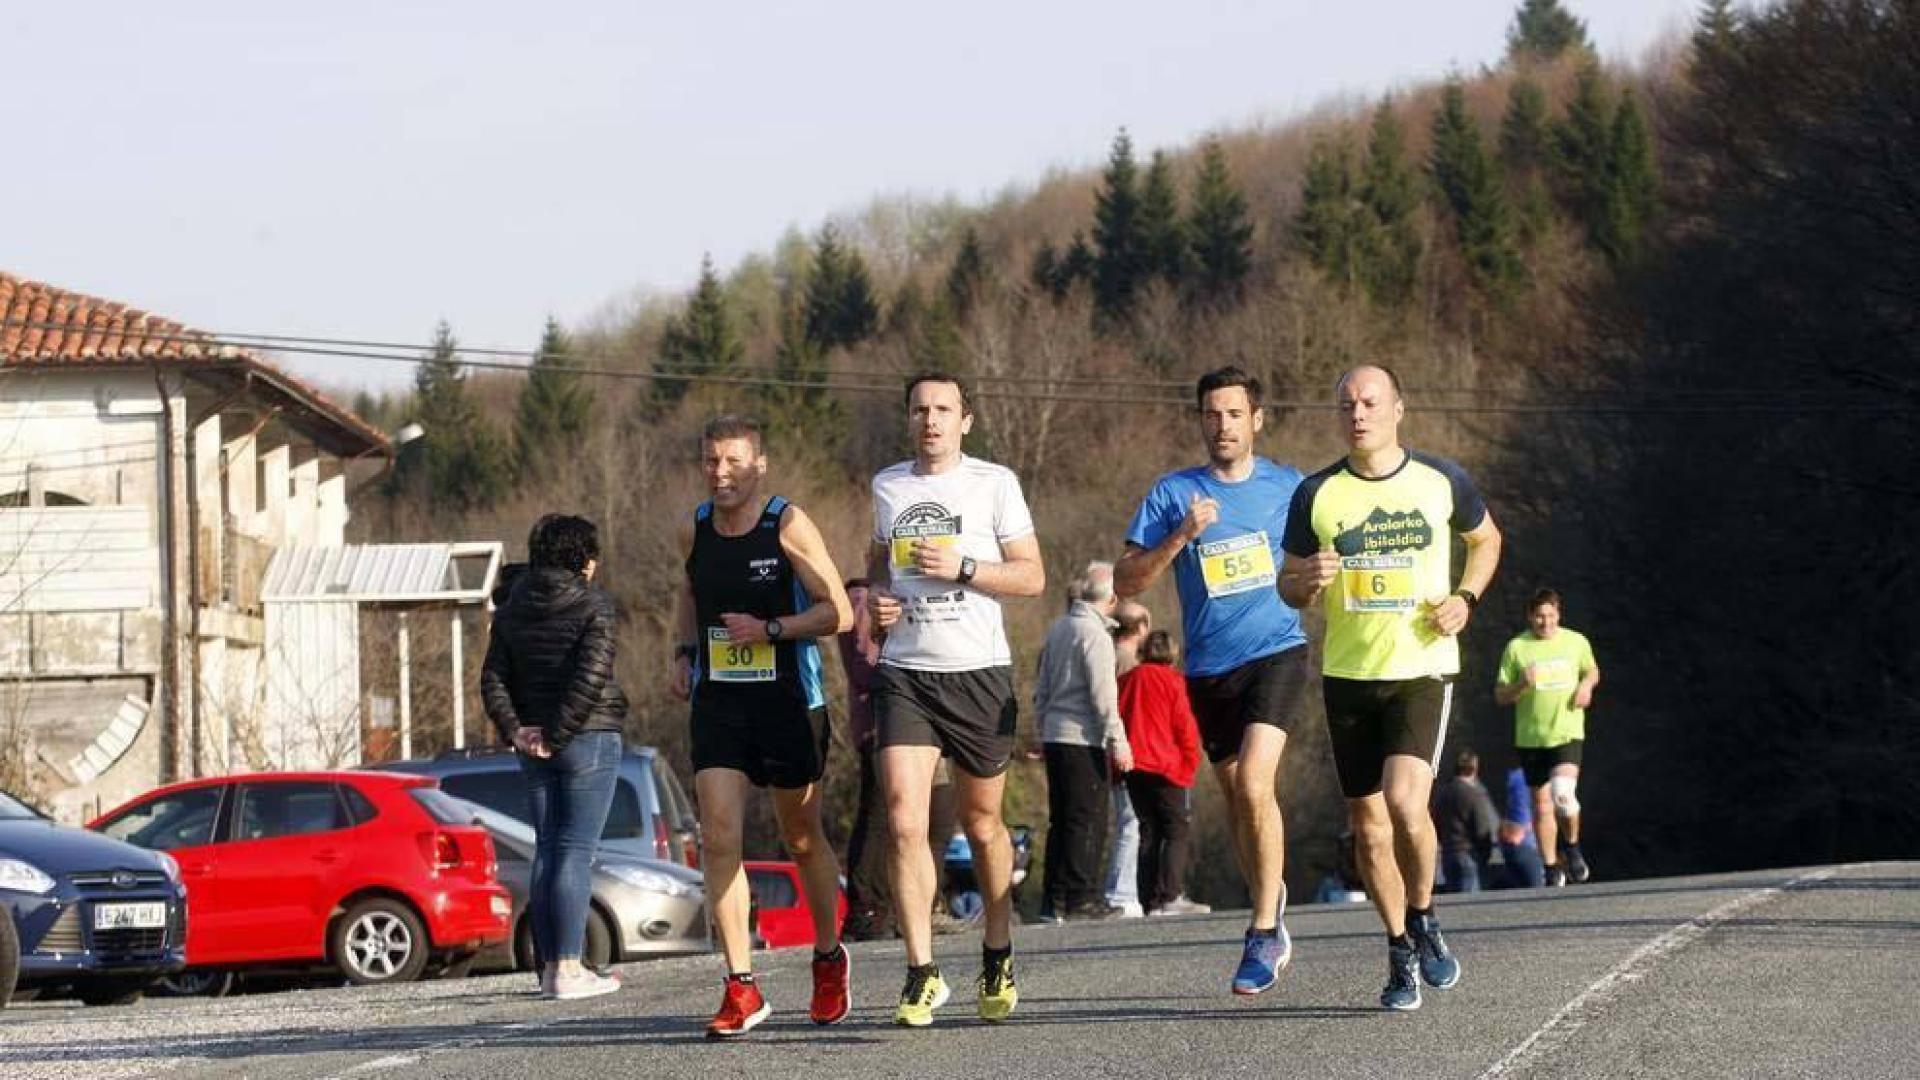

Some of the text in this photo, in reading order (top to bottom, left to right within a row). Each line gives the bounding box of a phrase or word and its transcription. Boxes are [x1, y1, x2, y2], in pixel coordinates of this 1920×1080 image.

[1363, 517, 1424, 533] Aralarko
[1223, 554, 1253, 578] 55
[1372, 573, 1386, 594] 6
[726, 645, 753, 666] 30
